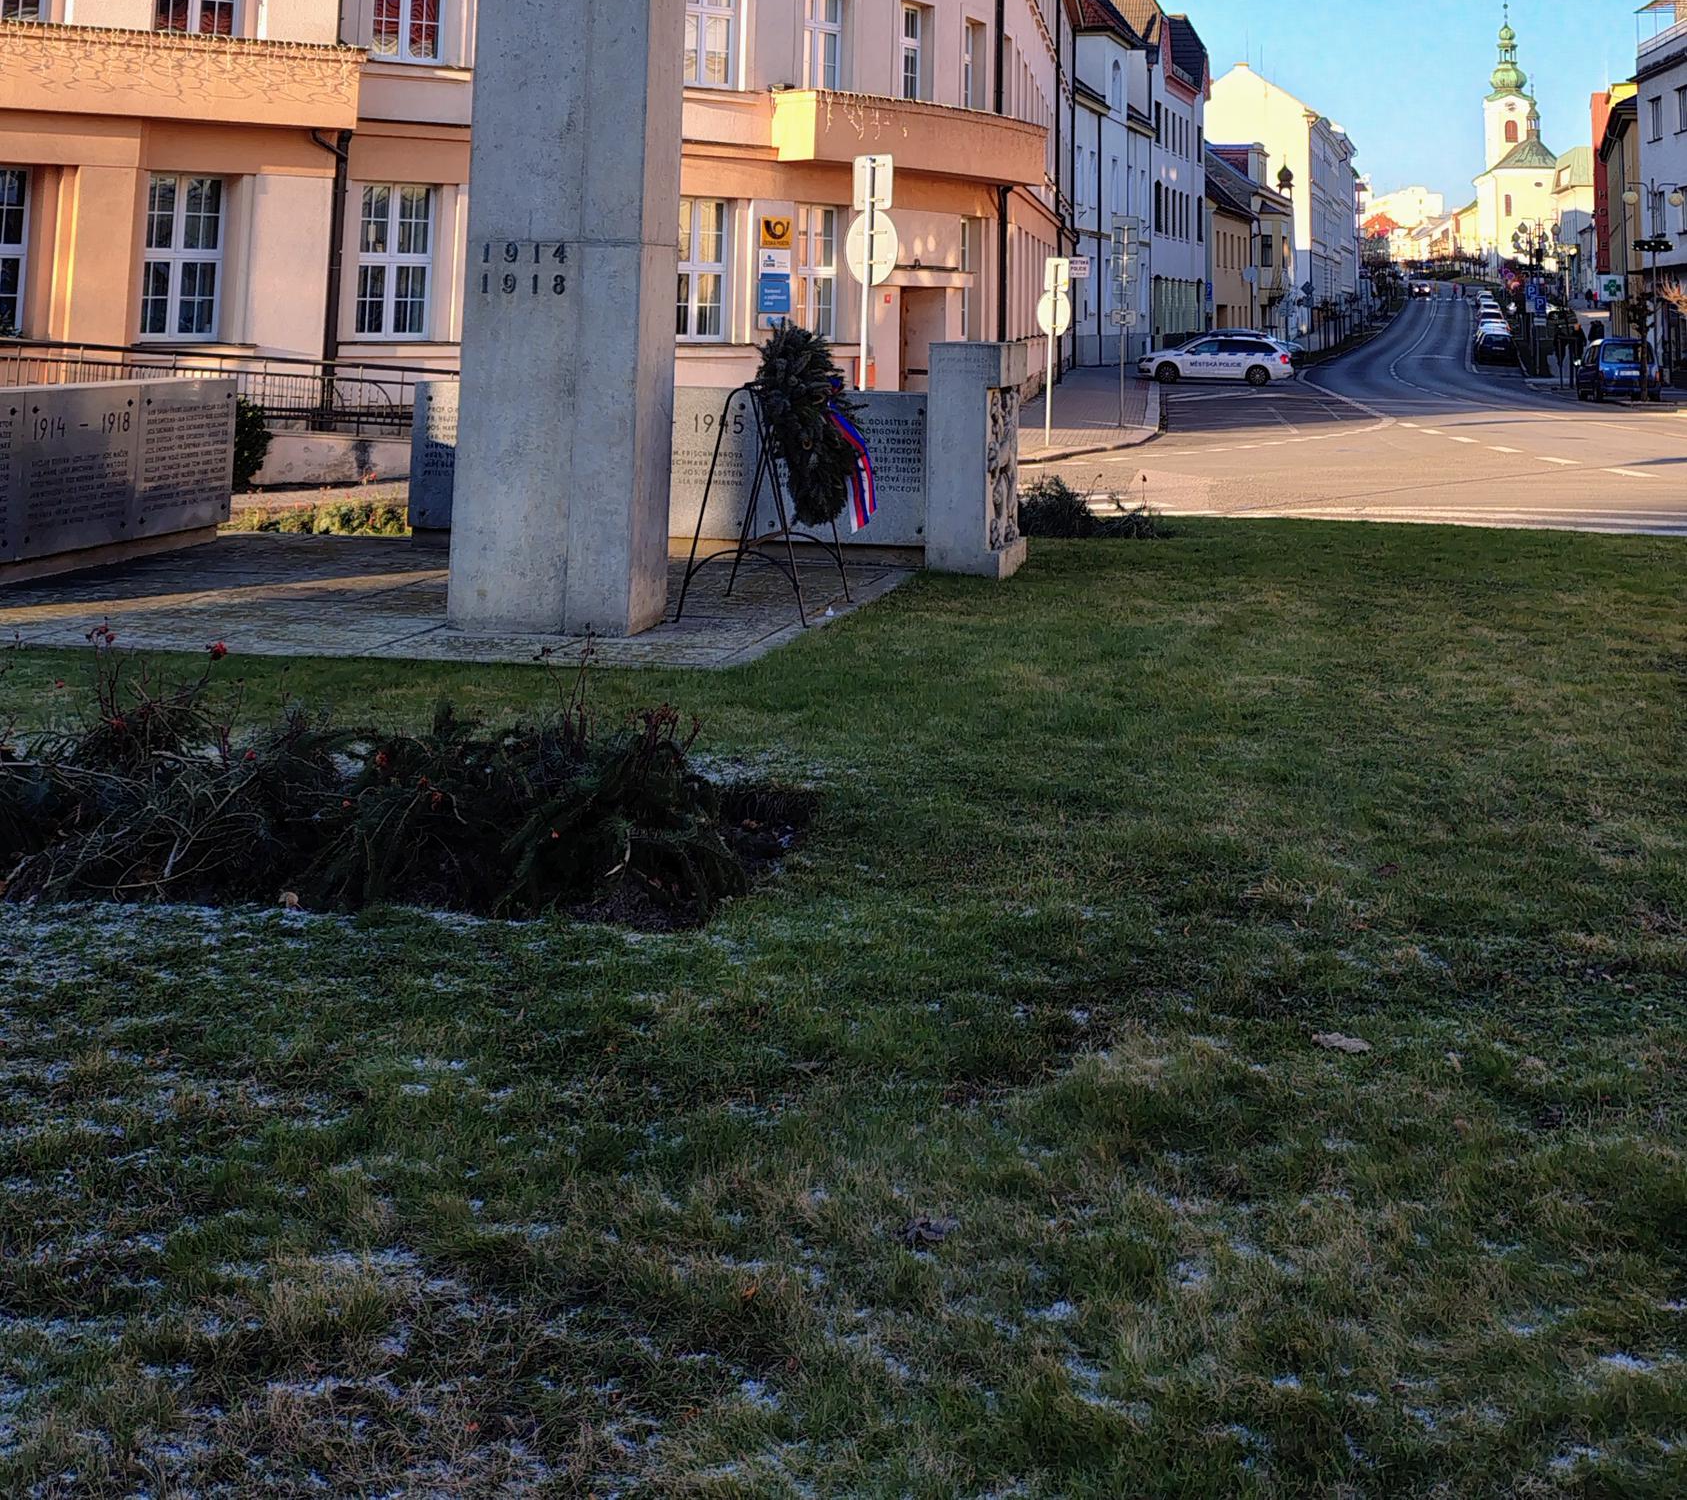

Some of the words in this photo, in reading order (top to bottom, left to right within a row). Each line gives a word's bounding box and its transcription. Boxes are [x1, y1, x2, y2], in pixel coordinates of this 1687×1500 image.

[482, 242, 567, 264] 1914
[481, 273, 566, 295] 1918
[1536, 299, 1544, 309] P
[1189, 359, 1218, 367] MĚSTSKÁ
[33, 417, 66, 441] 1914
[101, 411, 131, 434] 1918
[694, 414, 745, 435] 1945
[702, 469, 743, 477] GLDSTEIN
